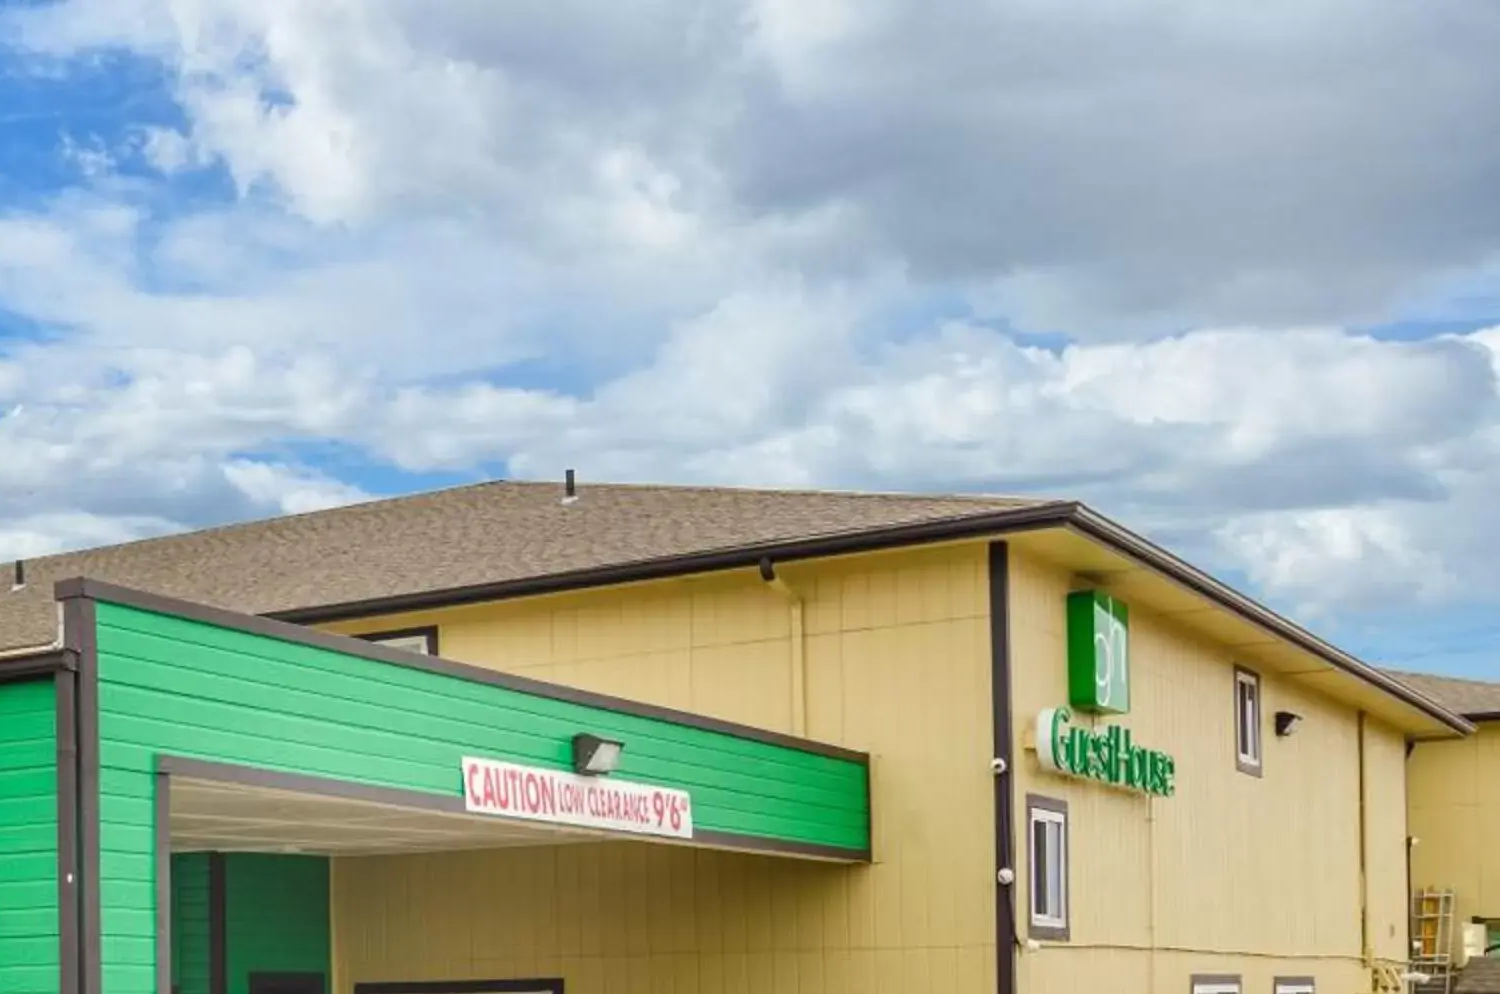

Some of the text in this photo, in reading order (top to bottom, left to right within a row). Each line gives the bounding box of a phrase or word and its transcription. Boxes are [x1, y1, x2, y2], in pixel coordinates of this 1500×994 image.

[468, 763, 556, 816] CAUTION
[557, 783, 585, 815] LOW
[587, 787, 651, 824] CLEARANCE
